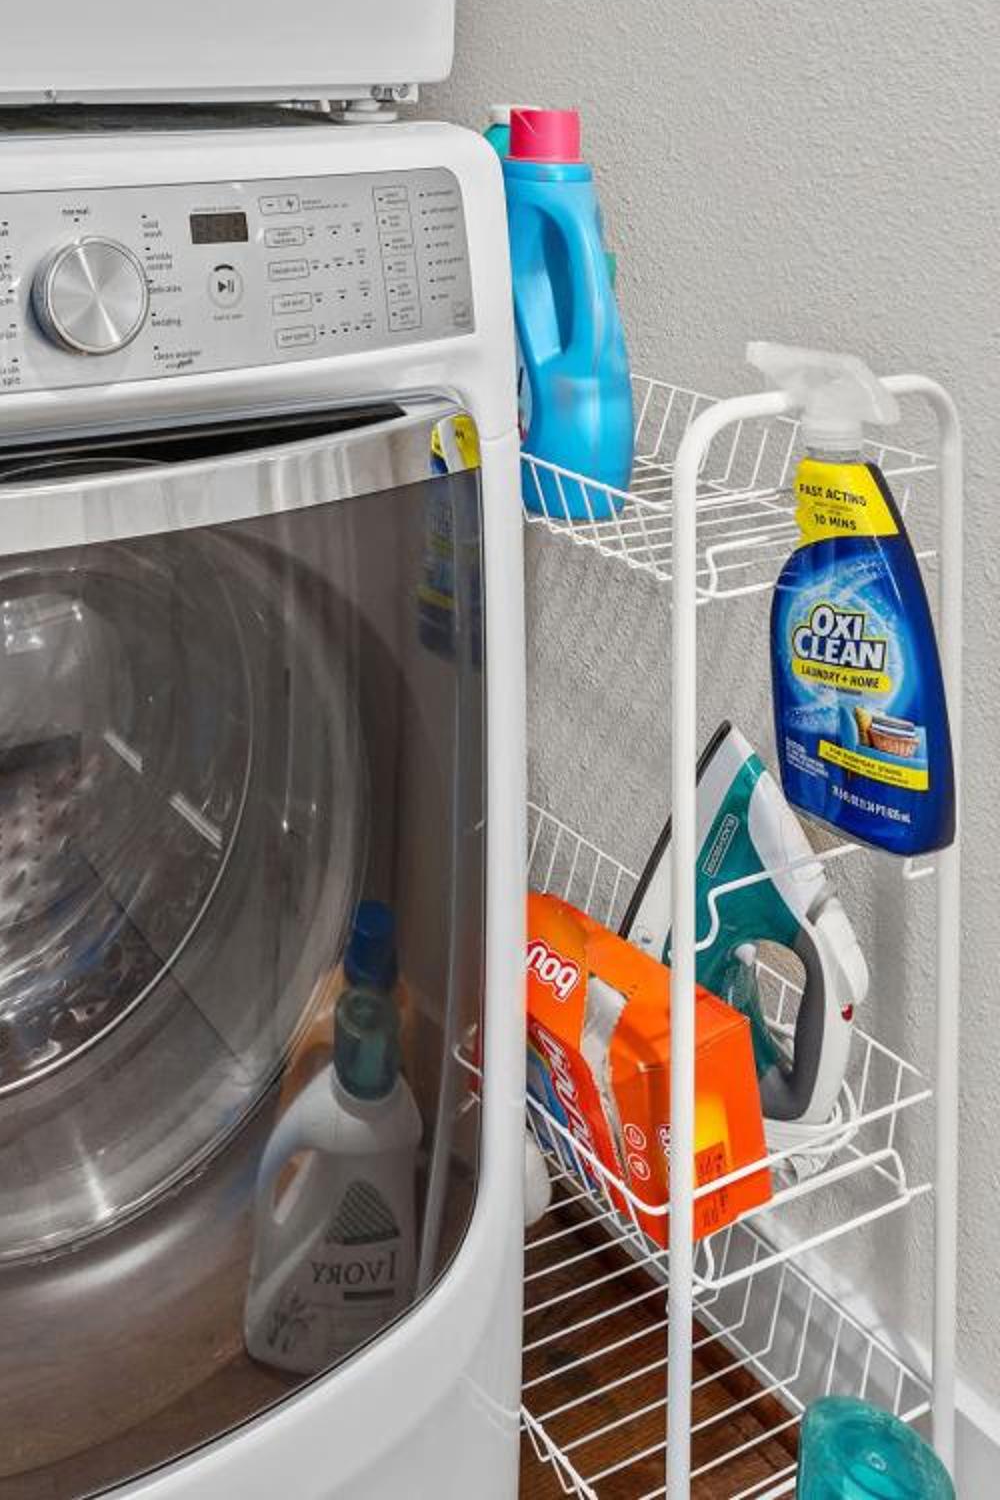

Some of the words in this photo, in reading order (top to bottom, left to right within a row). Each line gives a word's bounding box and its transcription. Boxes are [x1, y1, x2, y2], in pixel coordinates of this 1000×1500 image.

[799, 483, 823, 497] FAST
[825, 488, 868, 507] ACTING
[813, 513, 827, 525] 10
[829, 515, 857, 531] MINS
[811, 605, 863, 641] OXI
[793, 626, 886, 670] CLEAN
[801, 664, 841, 685] LAUNDRY
[850, 674, 880, 689] HOME
